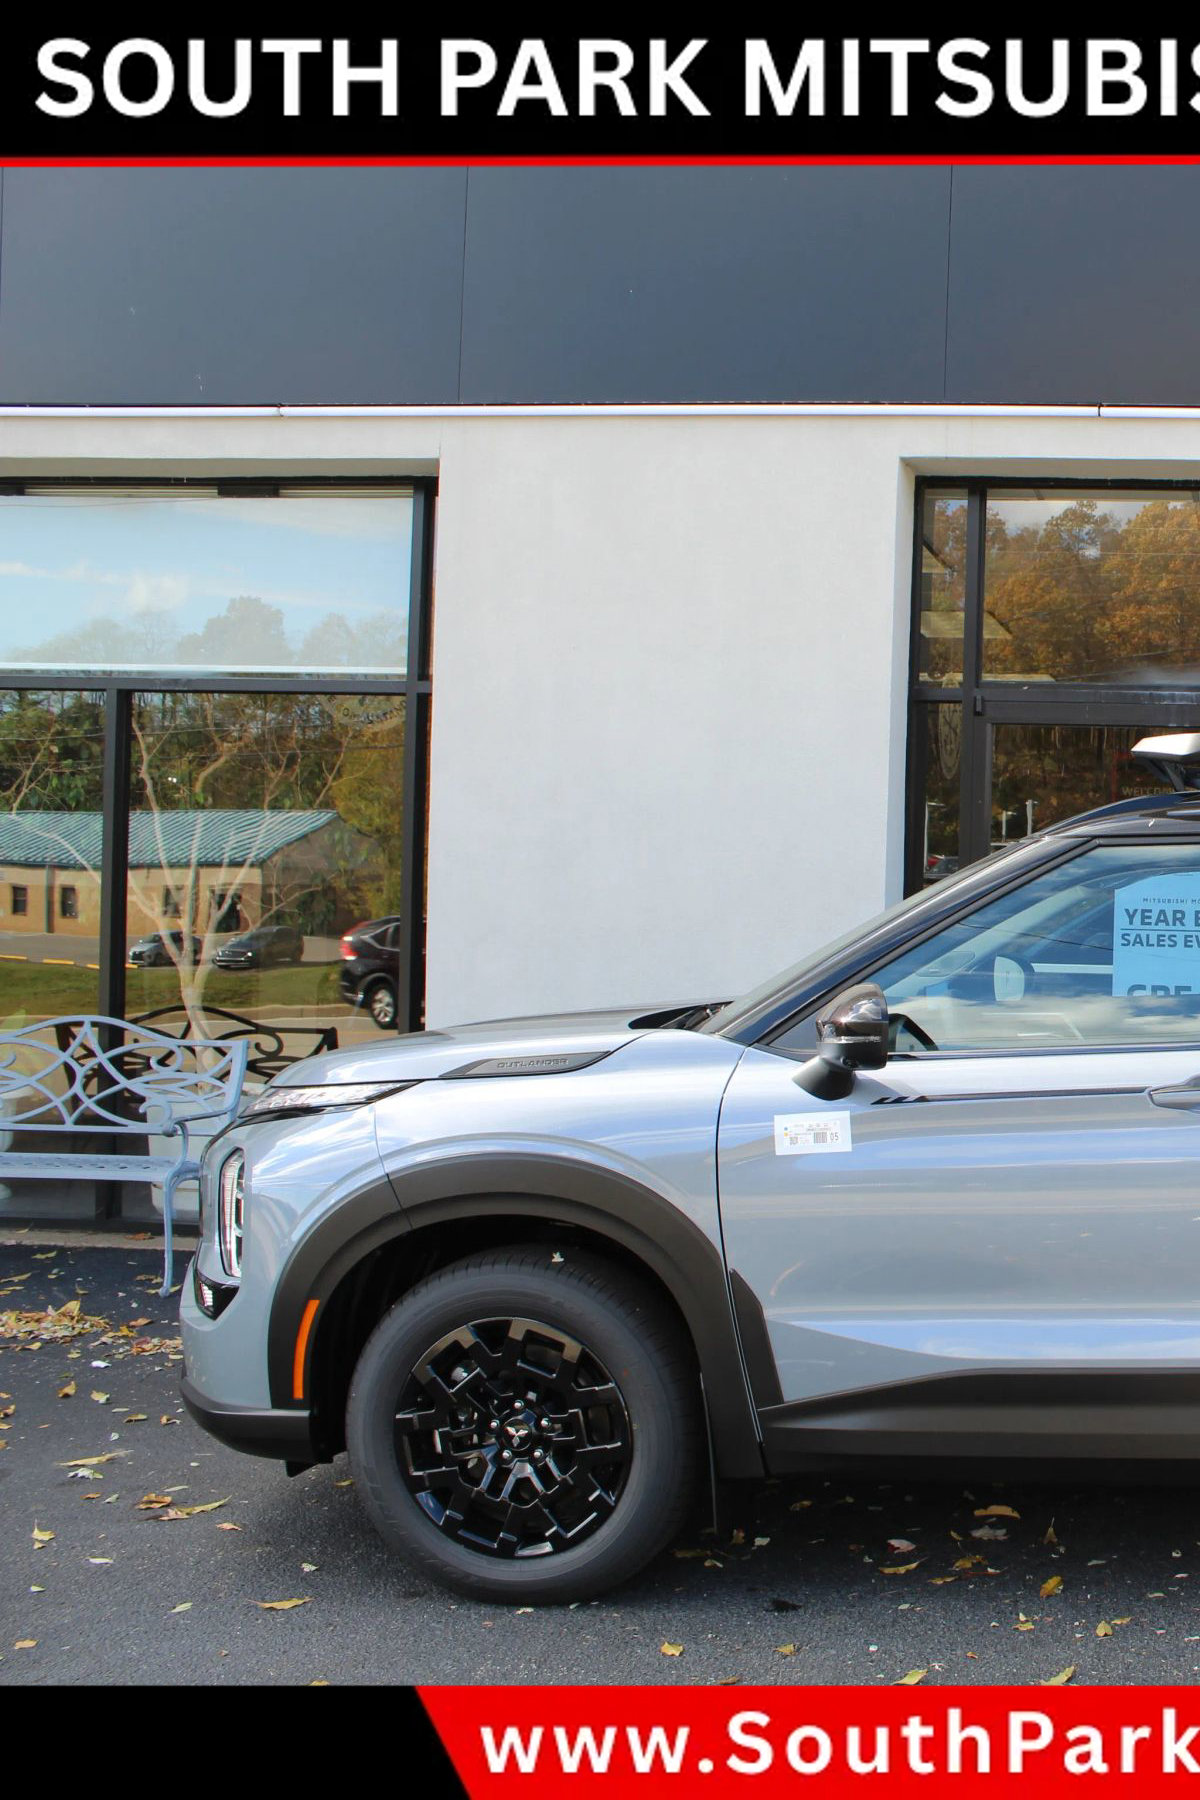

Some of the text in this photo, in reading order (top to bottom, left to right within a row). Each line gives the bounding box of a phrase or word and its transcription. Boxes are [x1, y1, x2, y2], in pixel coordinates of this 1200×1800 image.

[1142, 897, 1188, 905] MITSUBISHI
[1124, 908, 1186, 927] YEAR
[1120, 932, 1178, 948] SALES
[497, 1058, 569, 1069] OUTLANDER
